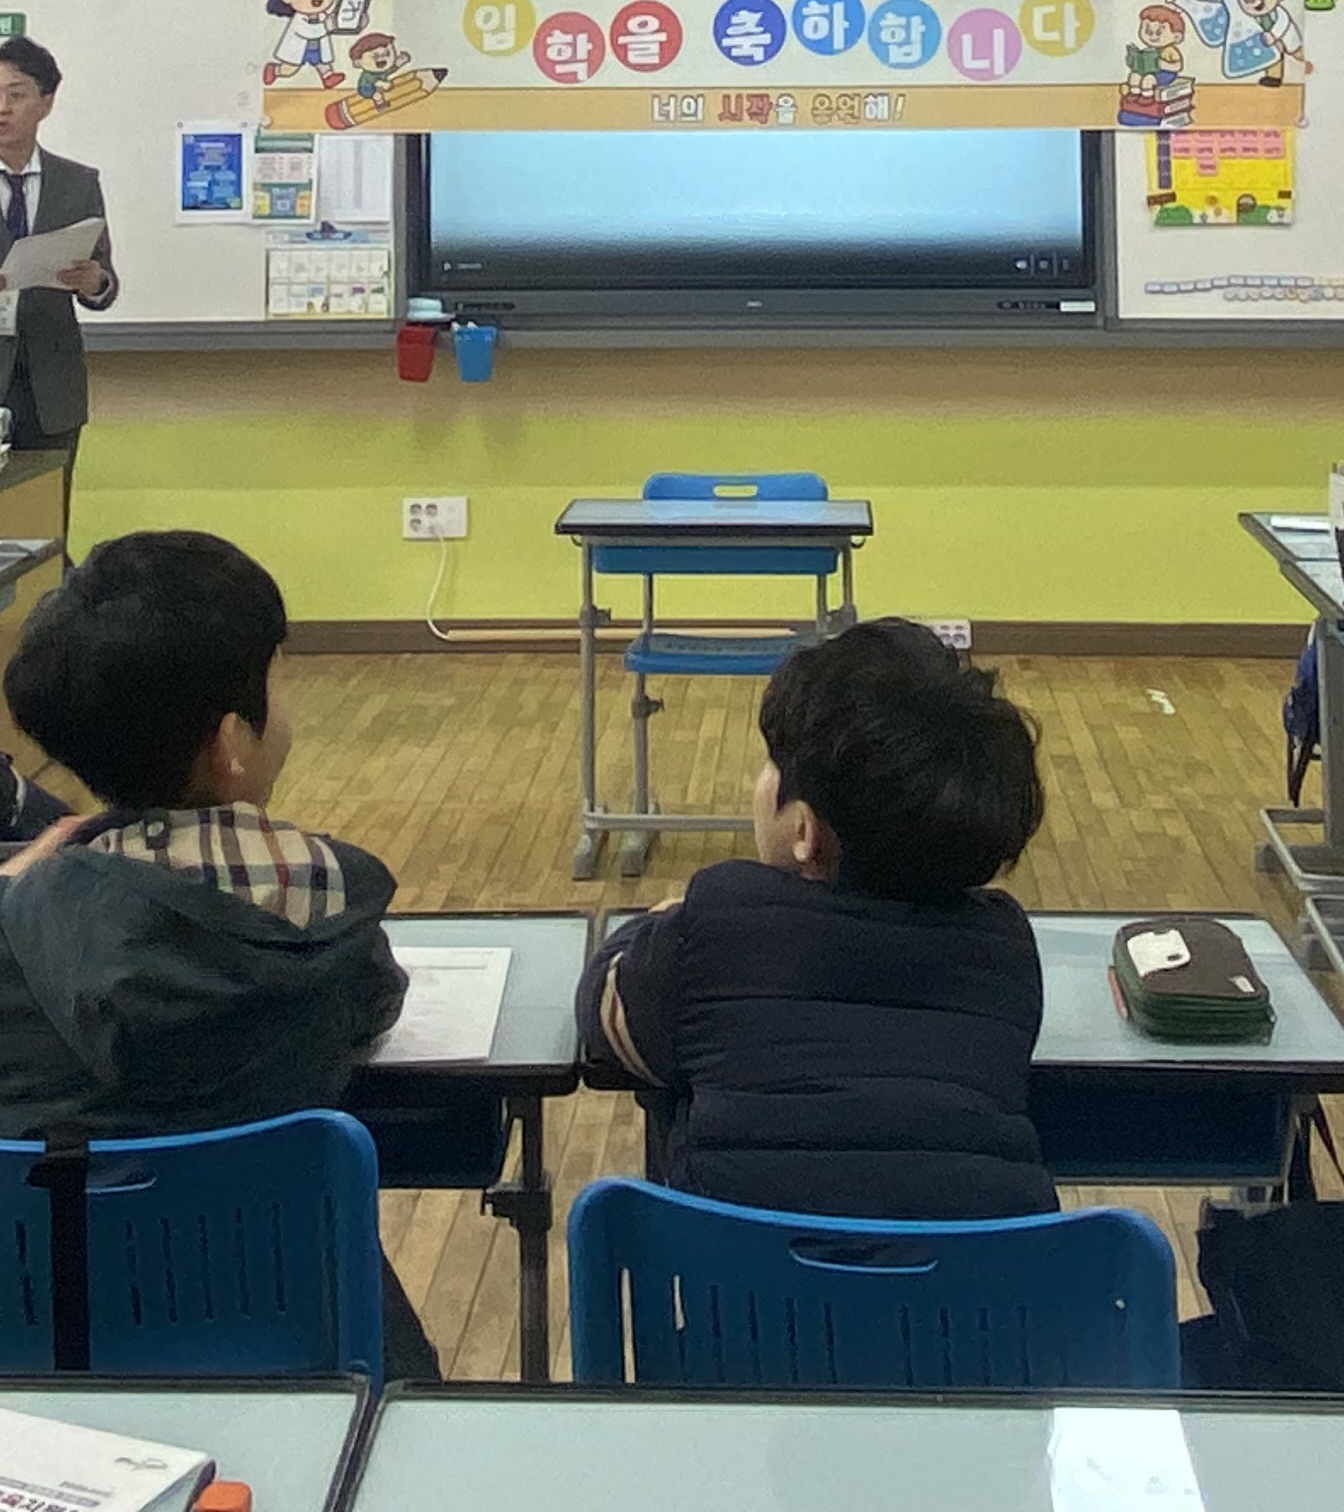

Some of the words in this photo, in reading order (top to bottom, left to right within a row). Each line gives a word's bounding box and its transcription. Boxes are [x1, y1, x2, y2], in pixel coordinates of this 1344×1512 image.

[474, 3, 667, 82] 입학을
[721, 0, 1081, 77] 축하합니다
[652, 92, 705, 124] 너의
[717, 92, 798, 126] 시작을
[811, 92, 906, 126] 응원해!
